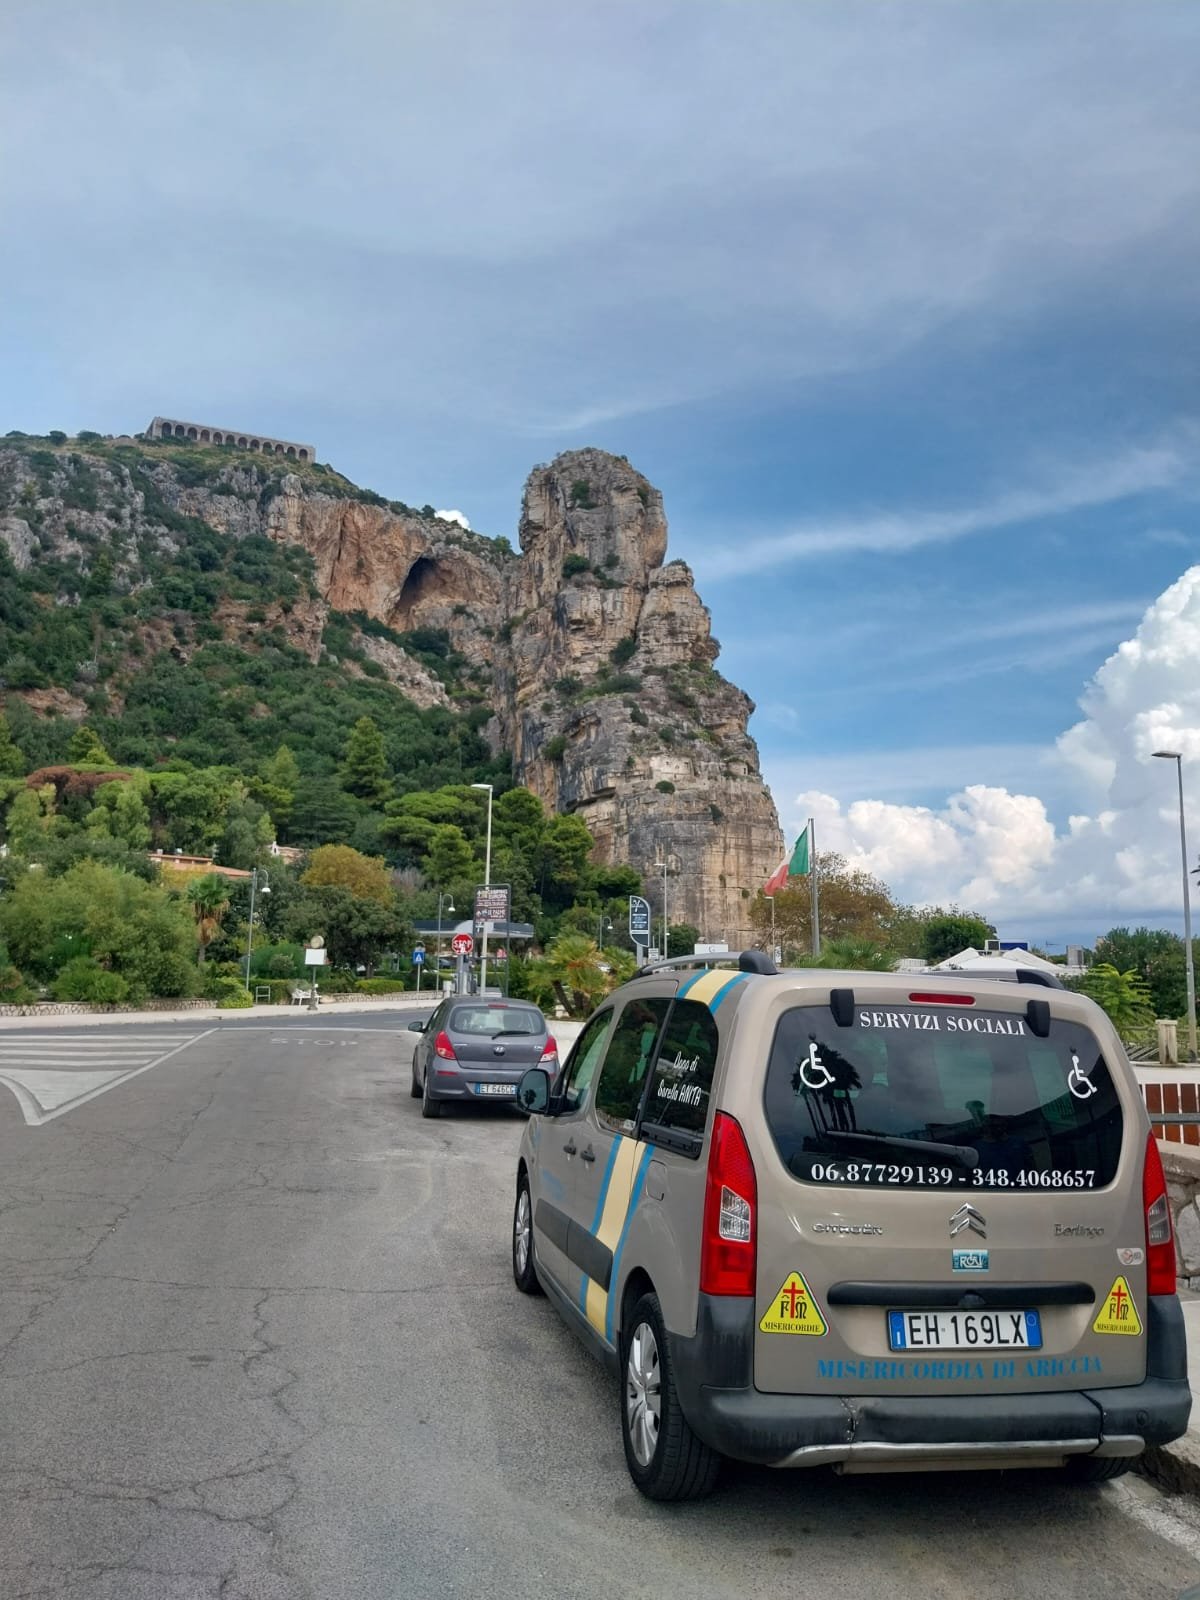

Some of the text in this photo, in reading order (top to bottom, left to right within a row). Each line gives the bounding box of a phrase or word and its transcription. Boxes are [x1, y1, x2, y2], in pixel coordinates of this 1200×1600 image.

[454, 940, 472, 949] STOP
[860, 1011, 1026, 1036] SERVIZI SOCIALI
[271, 1038, 359, 1046] STOP
[657, 1079, 702, 1106] Sorella ANITA
[811, 1163, 953, 1185] 06.87729139
[972, 1168, 1096, 1188] 348.4068657
[1054, 1223, 1105, 1239] Berlingo
[764, 1321, 821, 1333] MISERICORDIE
[908, 1315, 940, 1345] EH
[950, 1314, 1025, 1345] 169LX
[816, 1356, 1104, 1379] MISERICORDIA DI ARICCIA
